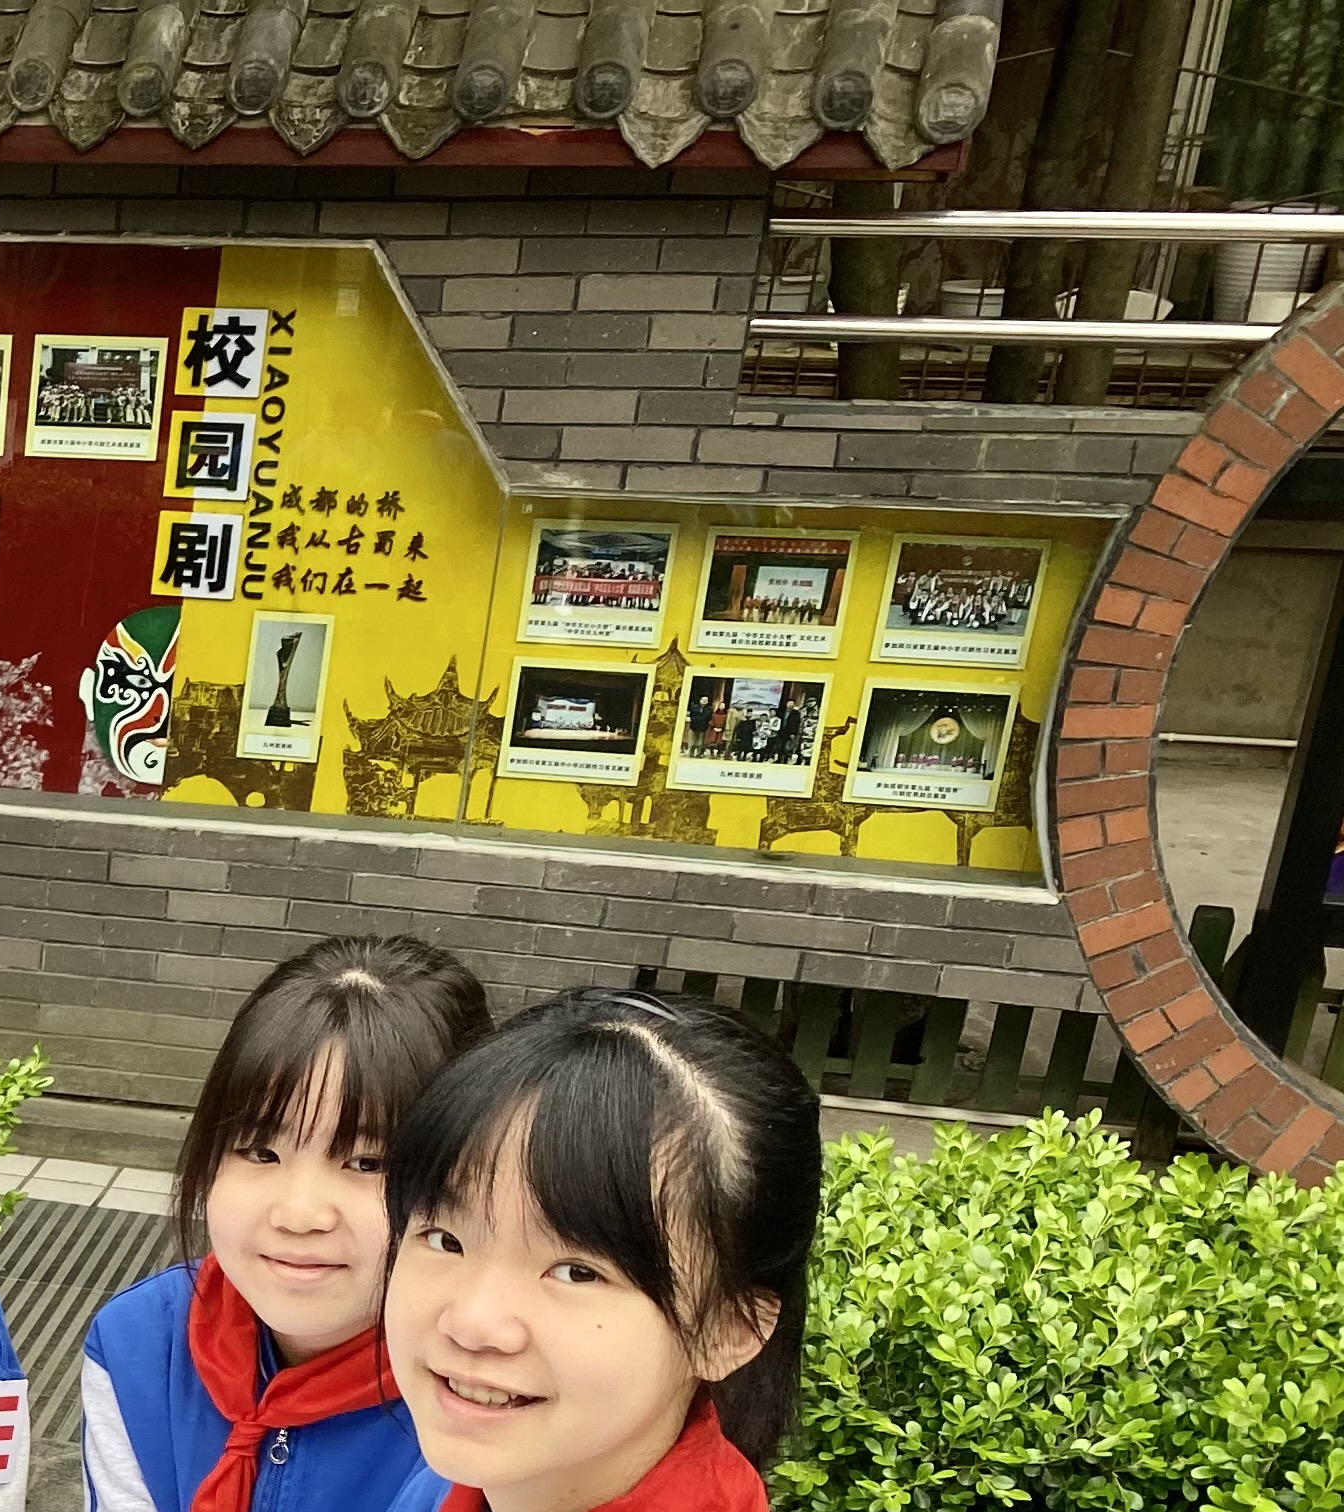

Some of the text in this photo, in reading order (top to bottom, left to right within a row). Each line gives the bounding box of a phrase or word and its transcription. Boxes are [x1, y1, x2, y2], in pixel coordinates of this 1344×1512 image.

[160, 315, 257, 592] 校园剧
[241, 309, 296, 599] XIAOYUANJU
[280, 485, 404, 519] 成都的桥
[277, 522, 428, 562] 我从古蜀来
[273, 563, 427, 602] 我们在一起
